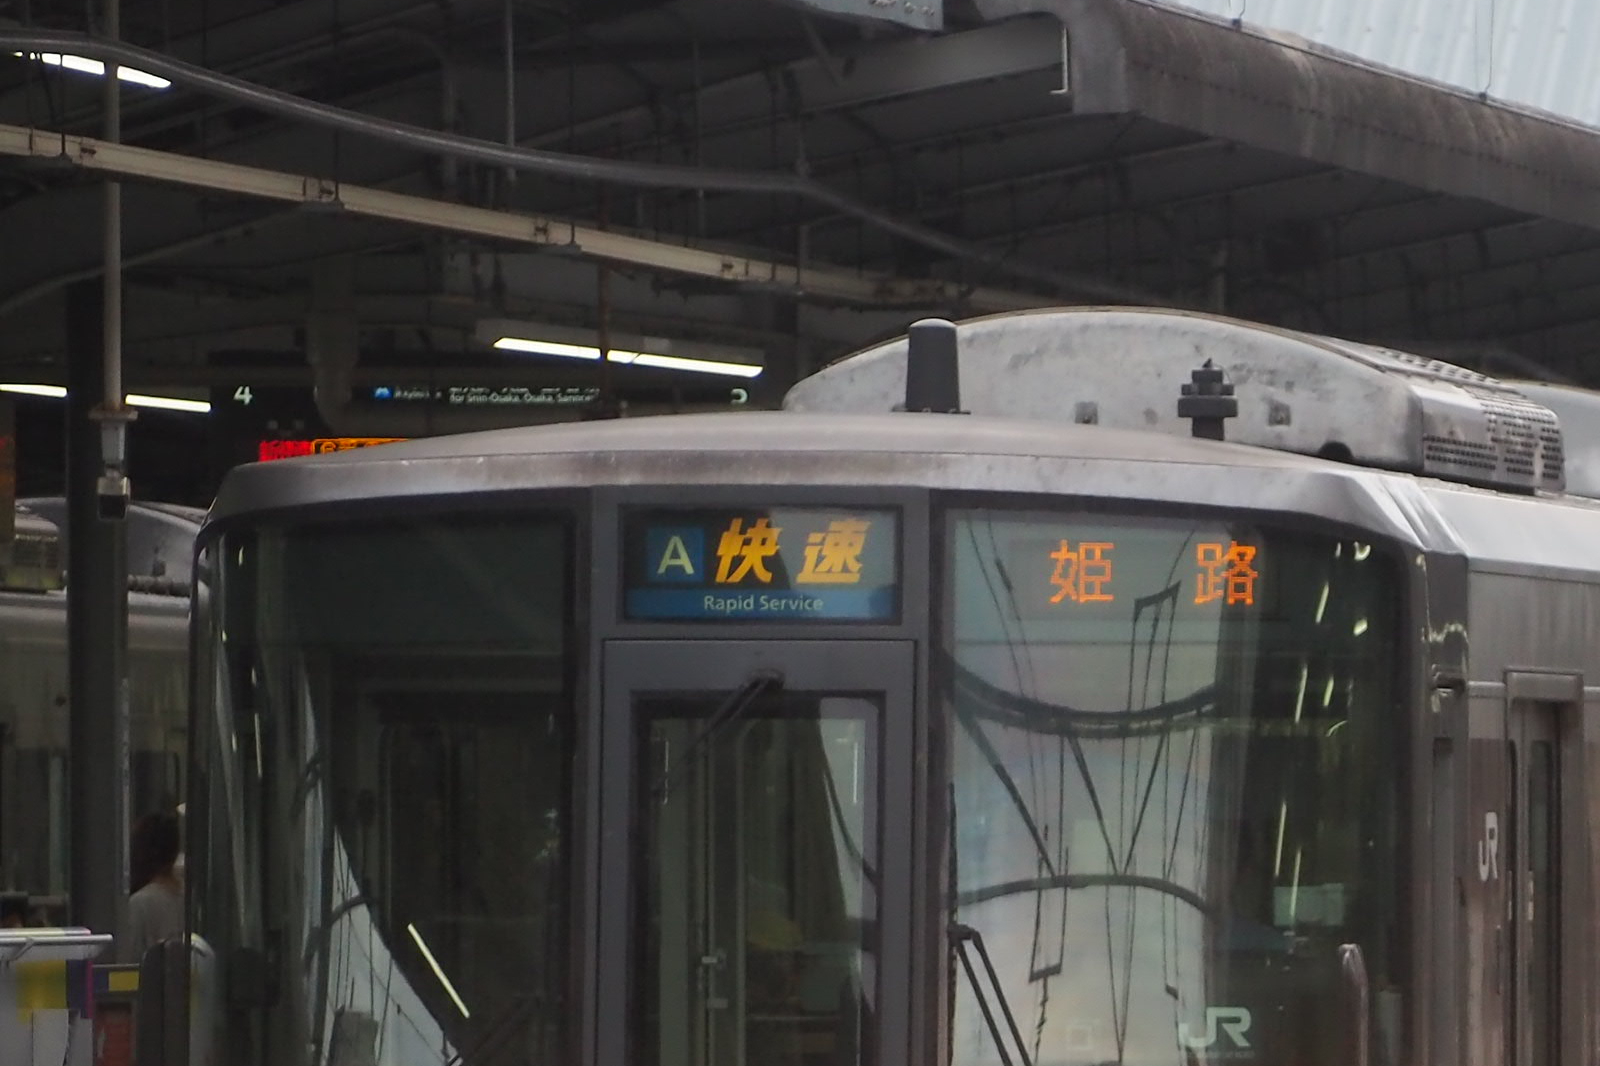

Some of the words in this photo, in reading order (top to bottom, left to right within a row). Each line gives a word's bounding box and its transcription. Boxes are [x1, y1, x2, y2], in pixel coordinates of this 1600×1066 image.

[233, 385, 253, 405] 4
[657, 535, 695, 575] A
[714, 517, 871, 584] 快速
[703, 595, 755, 613] Rapid
[759, 594, 824, 611] Service
[1478, 811, 1498, 882] JR
[1178, 1006, 1252, 1048] JR
